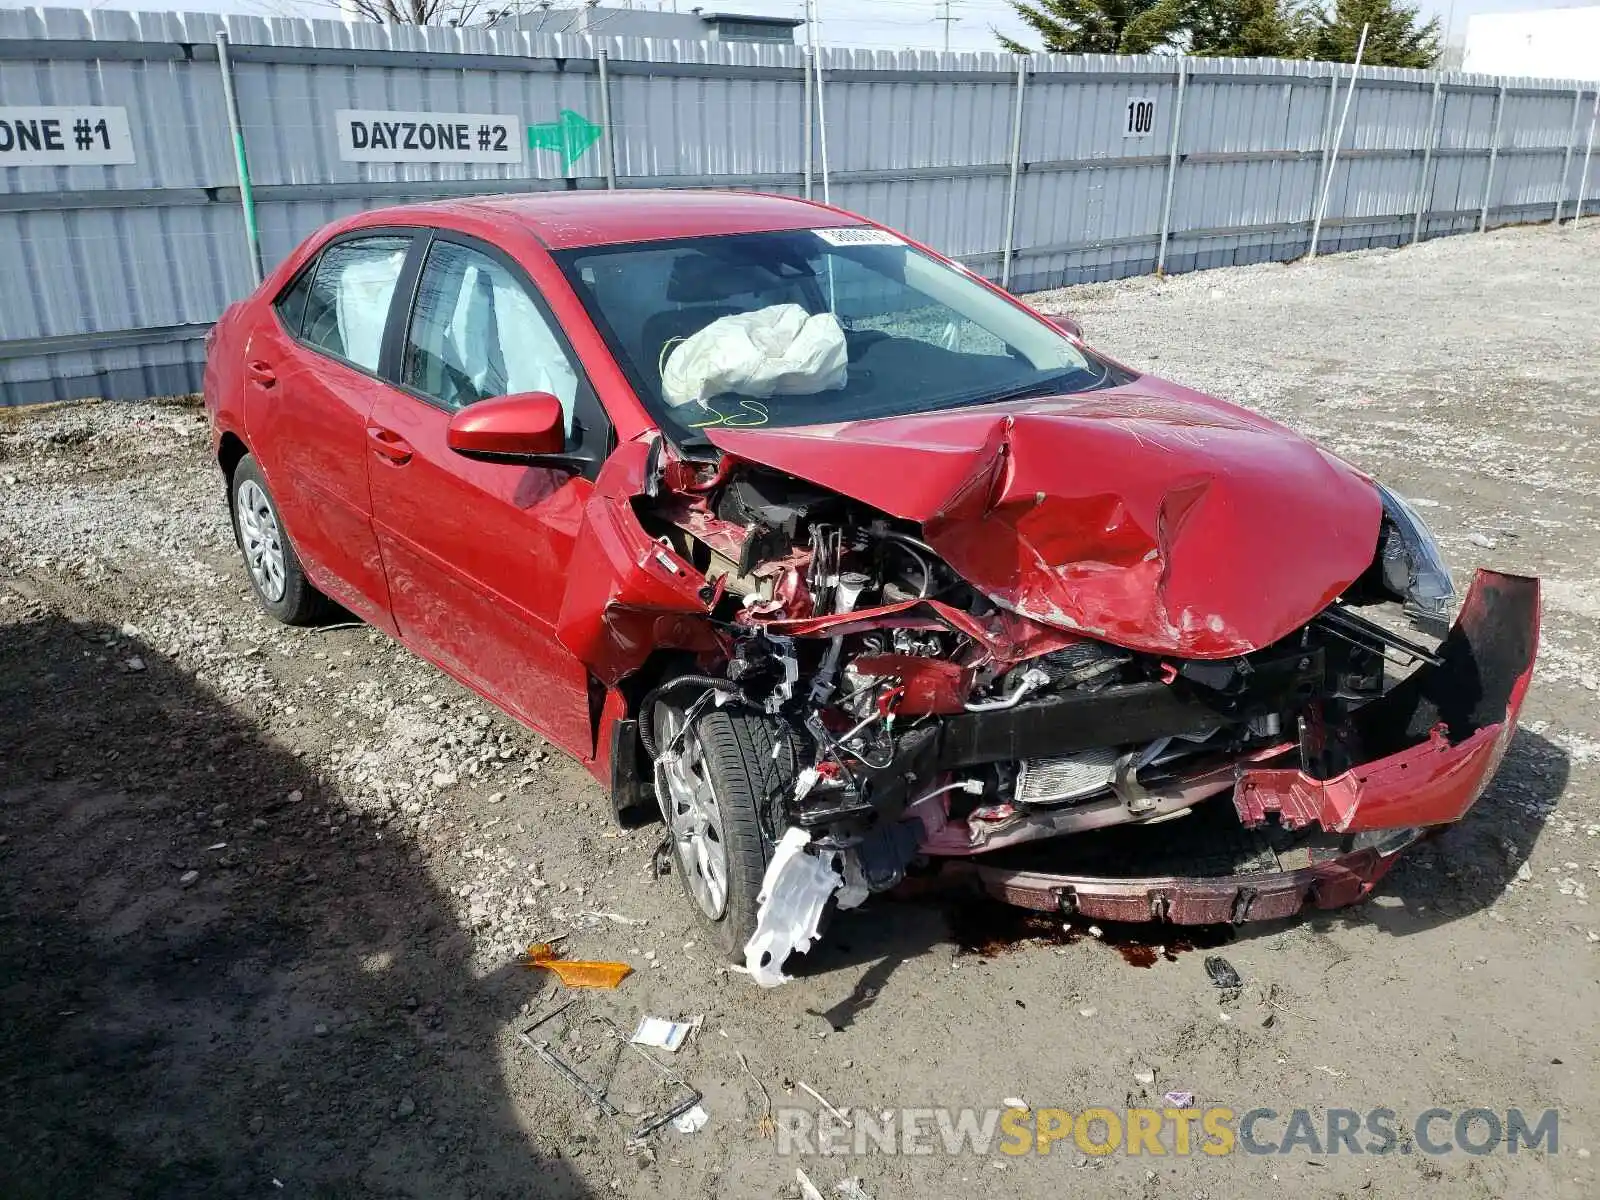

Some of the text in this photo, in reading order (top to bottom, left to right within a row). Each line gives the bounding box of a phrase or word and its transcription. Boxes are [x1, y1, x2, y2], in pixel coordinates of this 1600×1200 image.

[1128, 101, 1153, 132] 100
[73, 118, 111, 150] #1
[350, 121, 509, 151] DAYZONE #2
